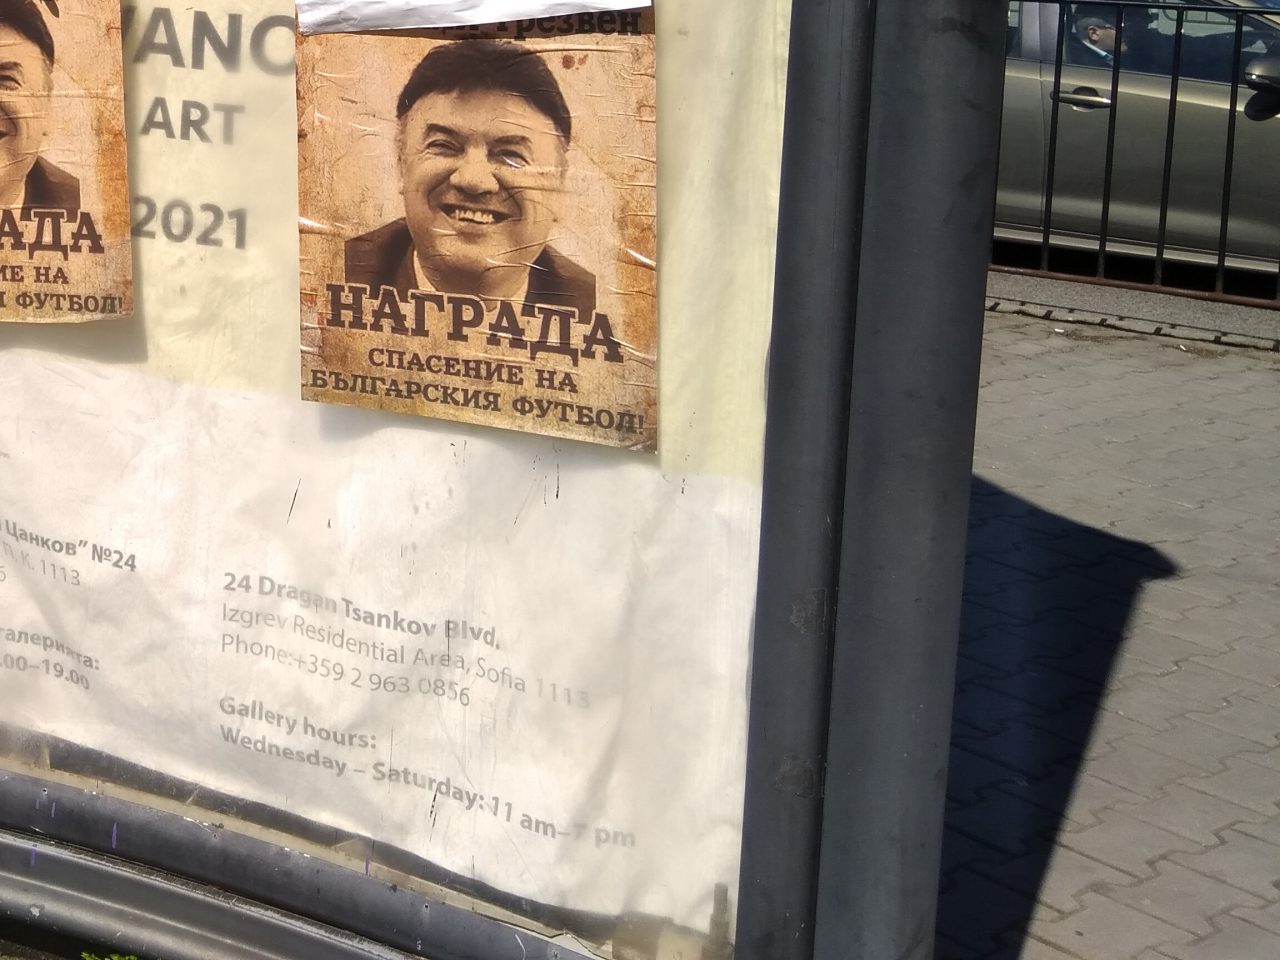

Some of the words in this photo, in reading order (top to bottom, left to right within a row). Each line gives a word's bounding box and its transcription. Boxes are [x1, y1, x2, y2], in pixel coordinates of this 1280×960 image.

[139, 96, 245, 146] ART
[33, 265, 70, 285] НА
[15, 292, 124, 315] ФУТБОЛ!
[325, 283, 625, 368] НАГРАДА
[368, 347, 524, 386] СПАСЕНИЕ
[535, 368, 579, 394] НА
[310, 368, 502, 413] БЪЛГАРСКИЯ
[511, 395, 646, 435] ФУТБОЛ!
[223, 572, 252, 593] 24
[258, 575, 337, 613] Dragan
[340, 597, 437, 637] Tsankov
[444, 619, 501, 650] Blvd.
[222, 602, 288, 630] Izgrev
[292, 614, 405, 665] Residential
[475, 656, 526, 693] Sofia
[350, 667, 363, 688] 2
[369, 672, 410, 694] 963
[219, 696, 298, 736] Gallery
[302, 715, 377, 749] hours:
[220, 724, 348, 777] Wednesday
[594, 826, 636, 848] pm
